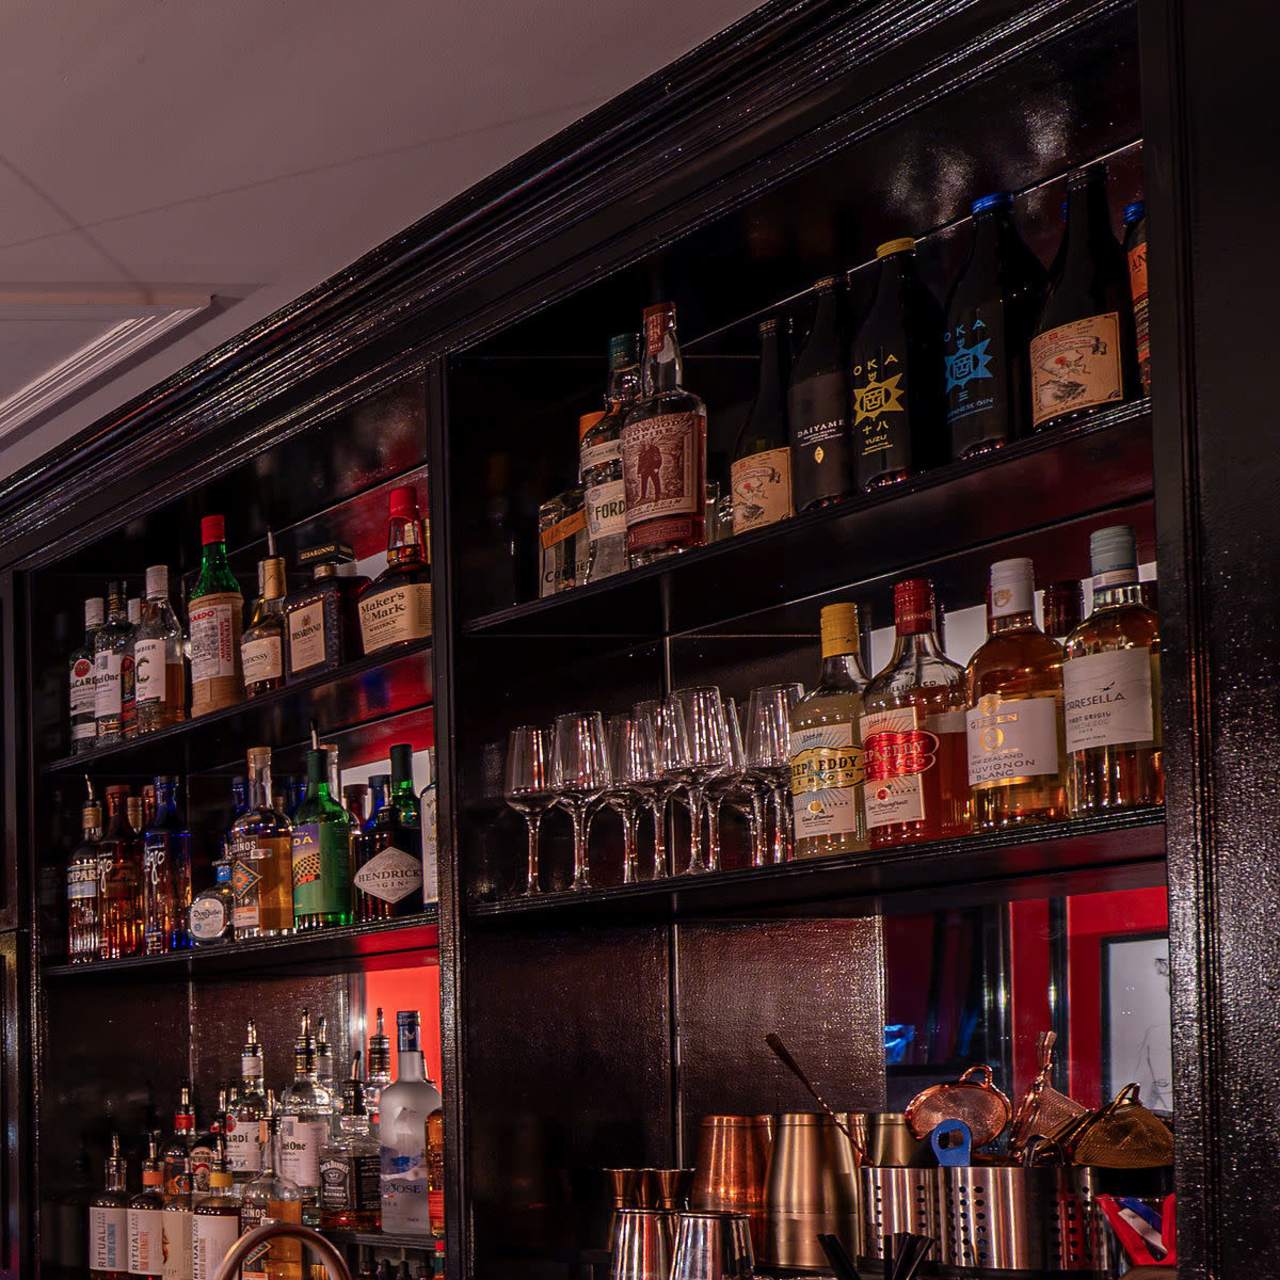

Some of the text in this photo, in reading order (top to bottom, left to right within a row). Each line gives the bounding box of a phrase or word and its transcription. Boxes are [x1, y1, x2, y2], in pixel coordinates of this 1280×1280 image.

[853, 353, 898, 376] OKA
[361, 591, 405, 613] Maker's
[818, 755, 859, 772] EDDY
[976, 769, 1015, 782] BLANC
[382, 880, 405, 889] GIN
[97, 1232, 107, 1268] RITUAL
[131, 1232, 140, 1271] RITUAL
